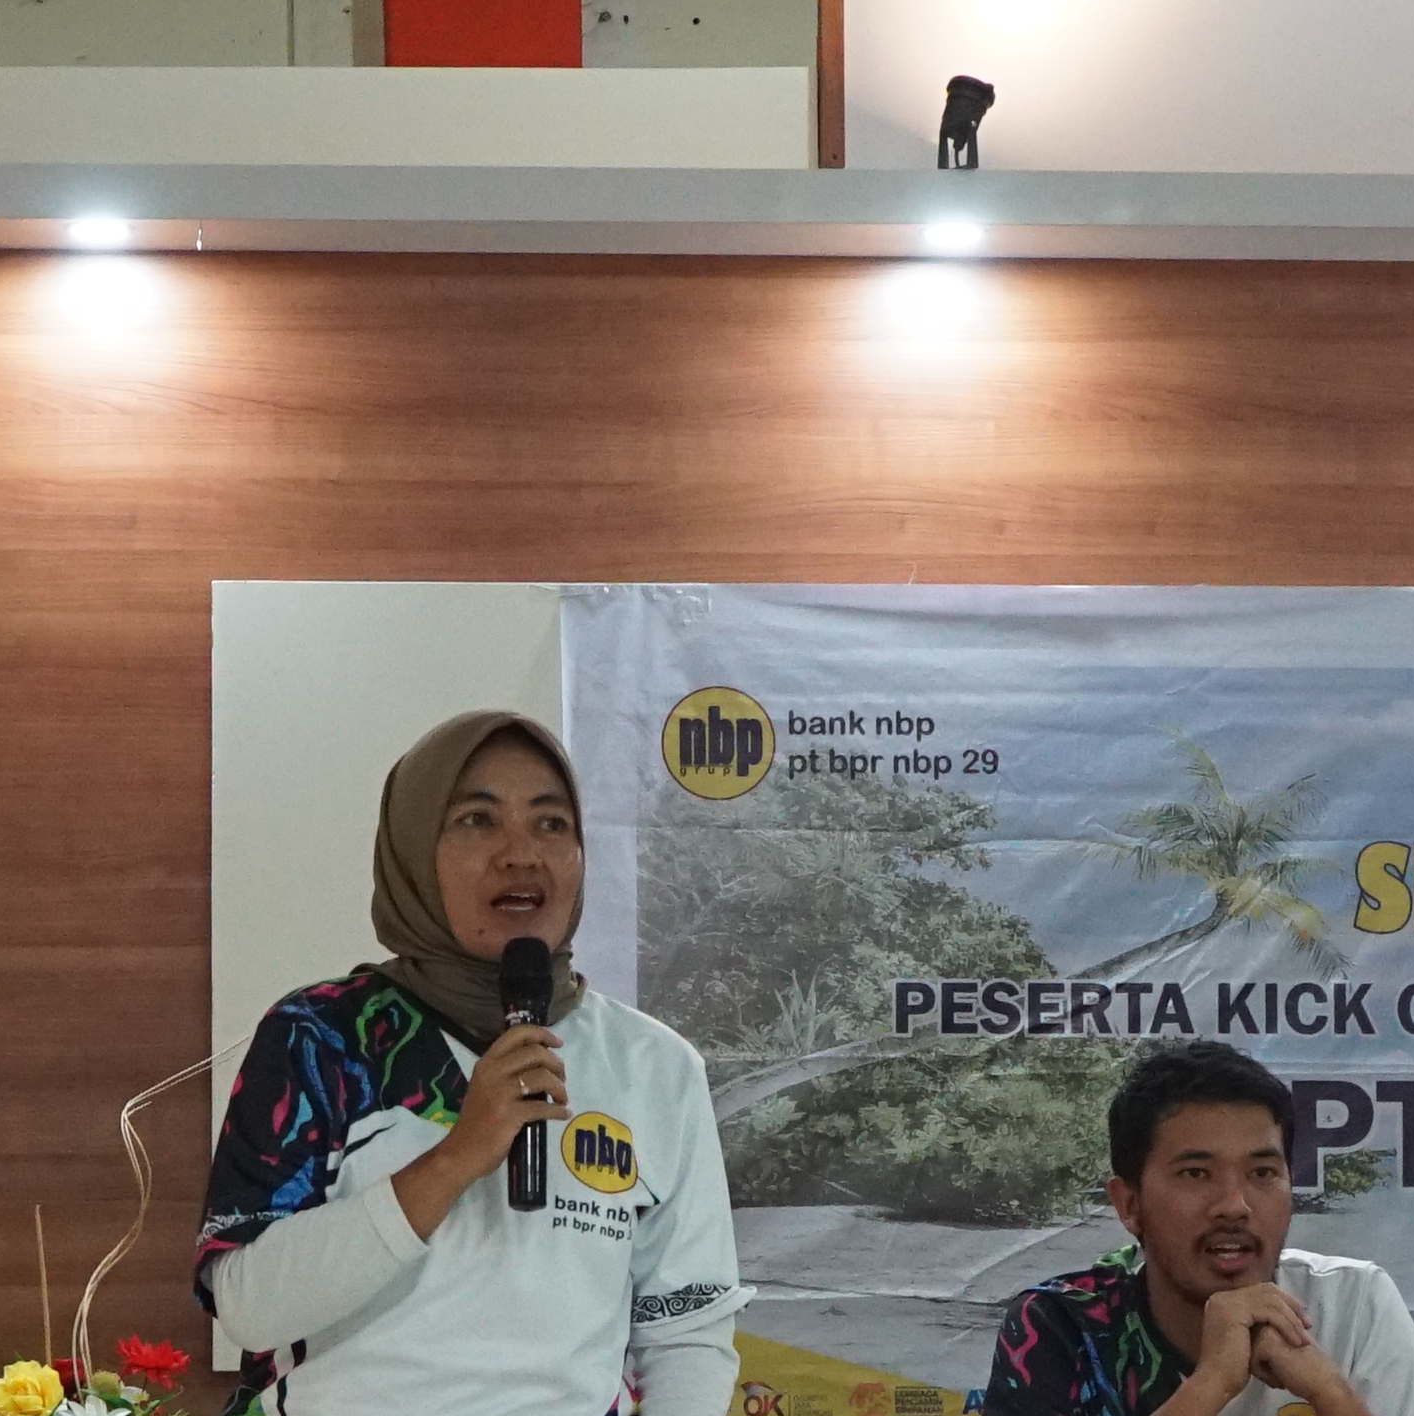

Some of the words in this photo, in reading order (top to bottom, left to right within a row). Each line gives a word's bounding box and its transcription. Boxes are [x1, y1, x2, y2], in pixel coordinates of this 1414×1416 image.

[679, 705, 763, 777] nbp
[788, 709, 866, 736] bank
[875, 709, 935, 743] nbp
[679, 765, 731, 778] grup
[788, 748, 820, 781] pt
[828, 748, 885, 781] bpr
[892, 748, 952, 781] nbp
[962, 748, 1000, 775] 29
[894, 981, 1196, 1035] PESERTA
[1216, 982, 1378, 1036] KICK
[574, 1123, 633, 1180] nbp
[554, 1194, 601, 1217] bank
[606, 1206, 630, 1223] nb
[552, 1216, 568, 1229] pt
[572, 1217, 596, 1234] bpr
[599, 1225, 625, 1242] nbp
